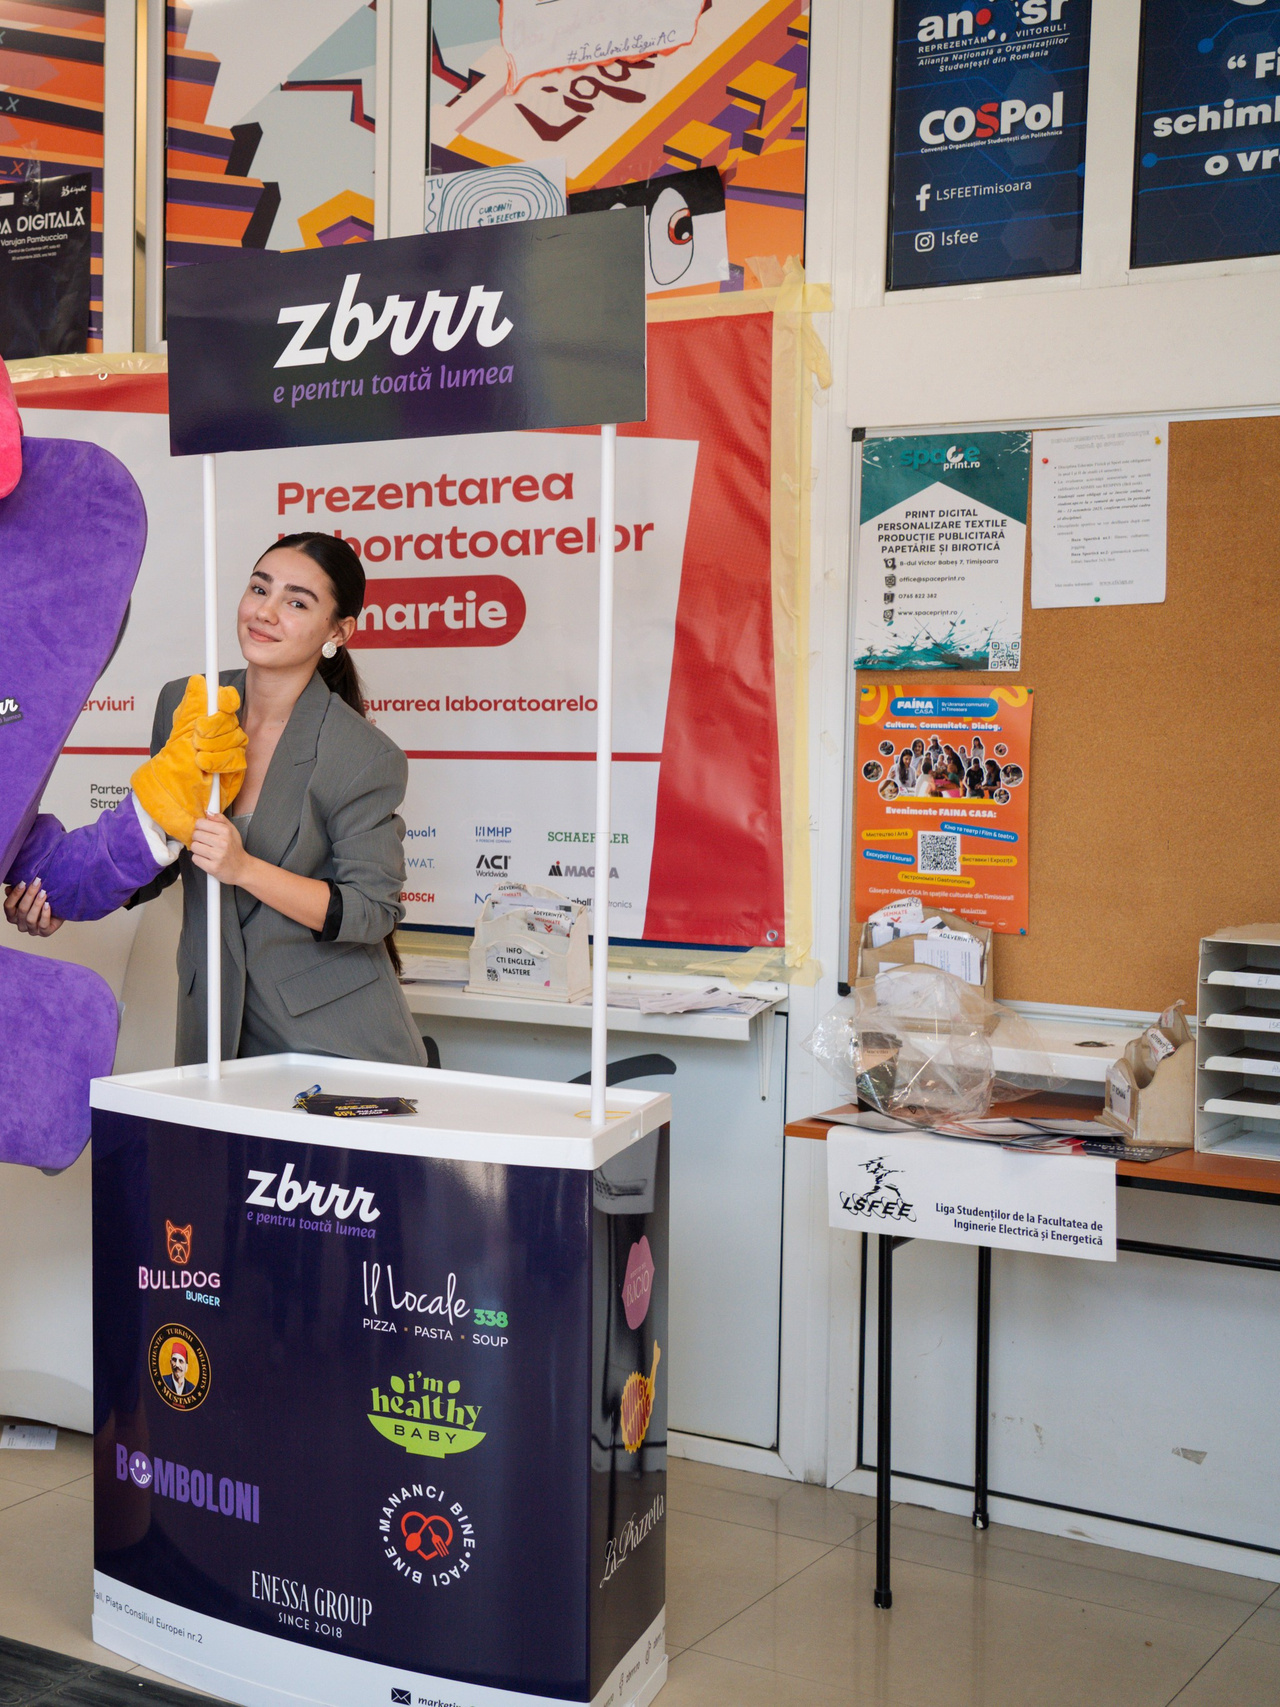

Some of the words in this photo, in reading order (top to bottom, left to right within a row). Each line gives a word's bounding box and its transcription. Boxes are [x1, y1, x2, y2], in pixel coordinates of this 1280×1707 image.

[918, 36, 987, 54] REPREZENTĂM
[1015, 23, 1066, 38] VIITORUL!
[952, 48, 993, 62] Națională
[993, 56, 1006, 65] din
[1010, 49, 1049, 61] România
[919, 91, 1064, 145] COSPol
[1204, 155, 1229, 176] o
[1236, 148, 1280, 172] vr
[427, 178, 444, 191] TU
[936, 181, 1032, 201] LSFEETimisoara
[496, 210, 525, 224] ELECTRO
[0, 237, 26, 247] Varujan
[26, 233, 68, 244] Pambuccian
[941, 230, 979, 246] lsfee
[272, 273, 514, 369] zbrrr
[273, 385, 285, 404] e
[291, 376, 364, 407] pentru
[371, 366, 432, 396] toată
[439, 363, 514, 388] lumea
[943, 461, 980, 471] print.ro
[277, 472, 574, 516] Prezentarea
[905, 510, 935, 519] PRINT
[938, 508, 978, 518] DIGITAL
[877, 520, 961, 531] PERSONALIZARE
[965, 519, 1007, 528] TEXTILE
[278, 517, 654, 563] boratoarelor
[878, 532, 935, 544] PRODUCȚIE
[938, 529, 1005, 540] PUBLICITARĂ
[881, 543, 936, 554] PAPETĂRIE
[939, 544, 948, 555] ȘI
[951, 541, 1000, 552] BIROTICĂ
[899, 575, 965, 583] office@spaceprint.ro
[81, 696, 135, 711] erviuri
[445, 695, 599, 712] laboratoarelo
[885, 721, 917, 729] Cultura.
[919, 721, 969, 729] Comunitate.
[885, 806, 937, 816] Evenimente
[939, 808, 967, 817] FAINA
[969, 809, 997, 818] CASA:
[406, 826, 436, 840] qual1
[547, 831, 629, 844] SCHAEFER
[404, 858, 435, 869] WAT.
[564, 865, 620, 879] MAGA
[476, 870, 508, 879] Worldwide
[400, 892, 435, 903] BOSCH
[506, 947, 522, 955] INFO
[496, 956, 507, 964] CTI
[508, 957, 536, 967] ENGLEZĂ
[502, 967, 531, 977] MASTERE
[245, 1163, 381, 1223] zbrrr
[247, 1211, 253, 1220] e
[256, 1211, 296, 1228] pentru
[299, 1217, 332, 1233] toată
[335, 1221, 377, 1239] lumea
[935, 1202, 955, 1216] Liga
[957, 1205, 1010, 1222] Studenților
[1012, 1211, 1024, 1222] de
[1026, 1212, 1035, 1223] la
[1037, 1214, 1088, 1230] Facultatea
[1091, 1221, 1103, 1231] de
[954, 1218, 996, 1234] Inginerie
[998, 1222, 1039, 1238] Electrică
[1041, 1230, 1048, 1241] și
[1051, 1230, 1103, 1246] Energetică
[138, 1266, 221, 1290] BULLDOG
[185, 1290, 221, 1307] BURGER
[387, 1264, 470, 1326] Locale
[473, 1308, 508, 1328] 338
[363, 1318, 397, 1333] PIZZA
[414, 1325, 453, 1341] PASTA
[472, 1334, 509, 1347] SOUP
[150, 1334, 164, 1377] AUTHENTIC
[165, 1328, 194, 1343] TURKISH
[196, 1347, 209, 1389] DELIGHTS
[161, 1387, 197, 1405] MUSTAFA
[371, 1387, 483, 1430] healthy
[394, 1424, 457, 1444] BABY
[378, 1484, 445, 1532] MANANCI
[450, 1502, 475, 1548] BINE
[384, 1545, 422, 1584] BINE
[432, 1558, 470, 1587] FACI
[252, 1570, 309, 1613] ENESSA
[314, 1587, 373, 1627] GROUP
[105, 1595, 123, 1612] Piața
[124, 1604, 154, 1624] Consiliul
[156, 1617, 185, 1637] Europei
[187, 1633, 203, 1644] nr.2
[278, 1612, 310, 1630] SINCE
[315, 1621, 343, 1639] 2018
